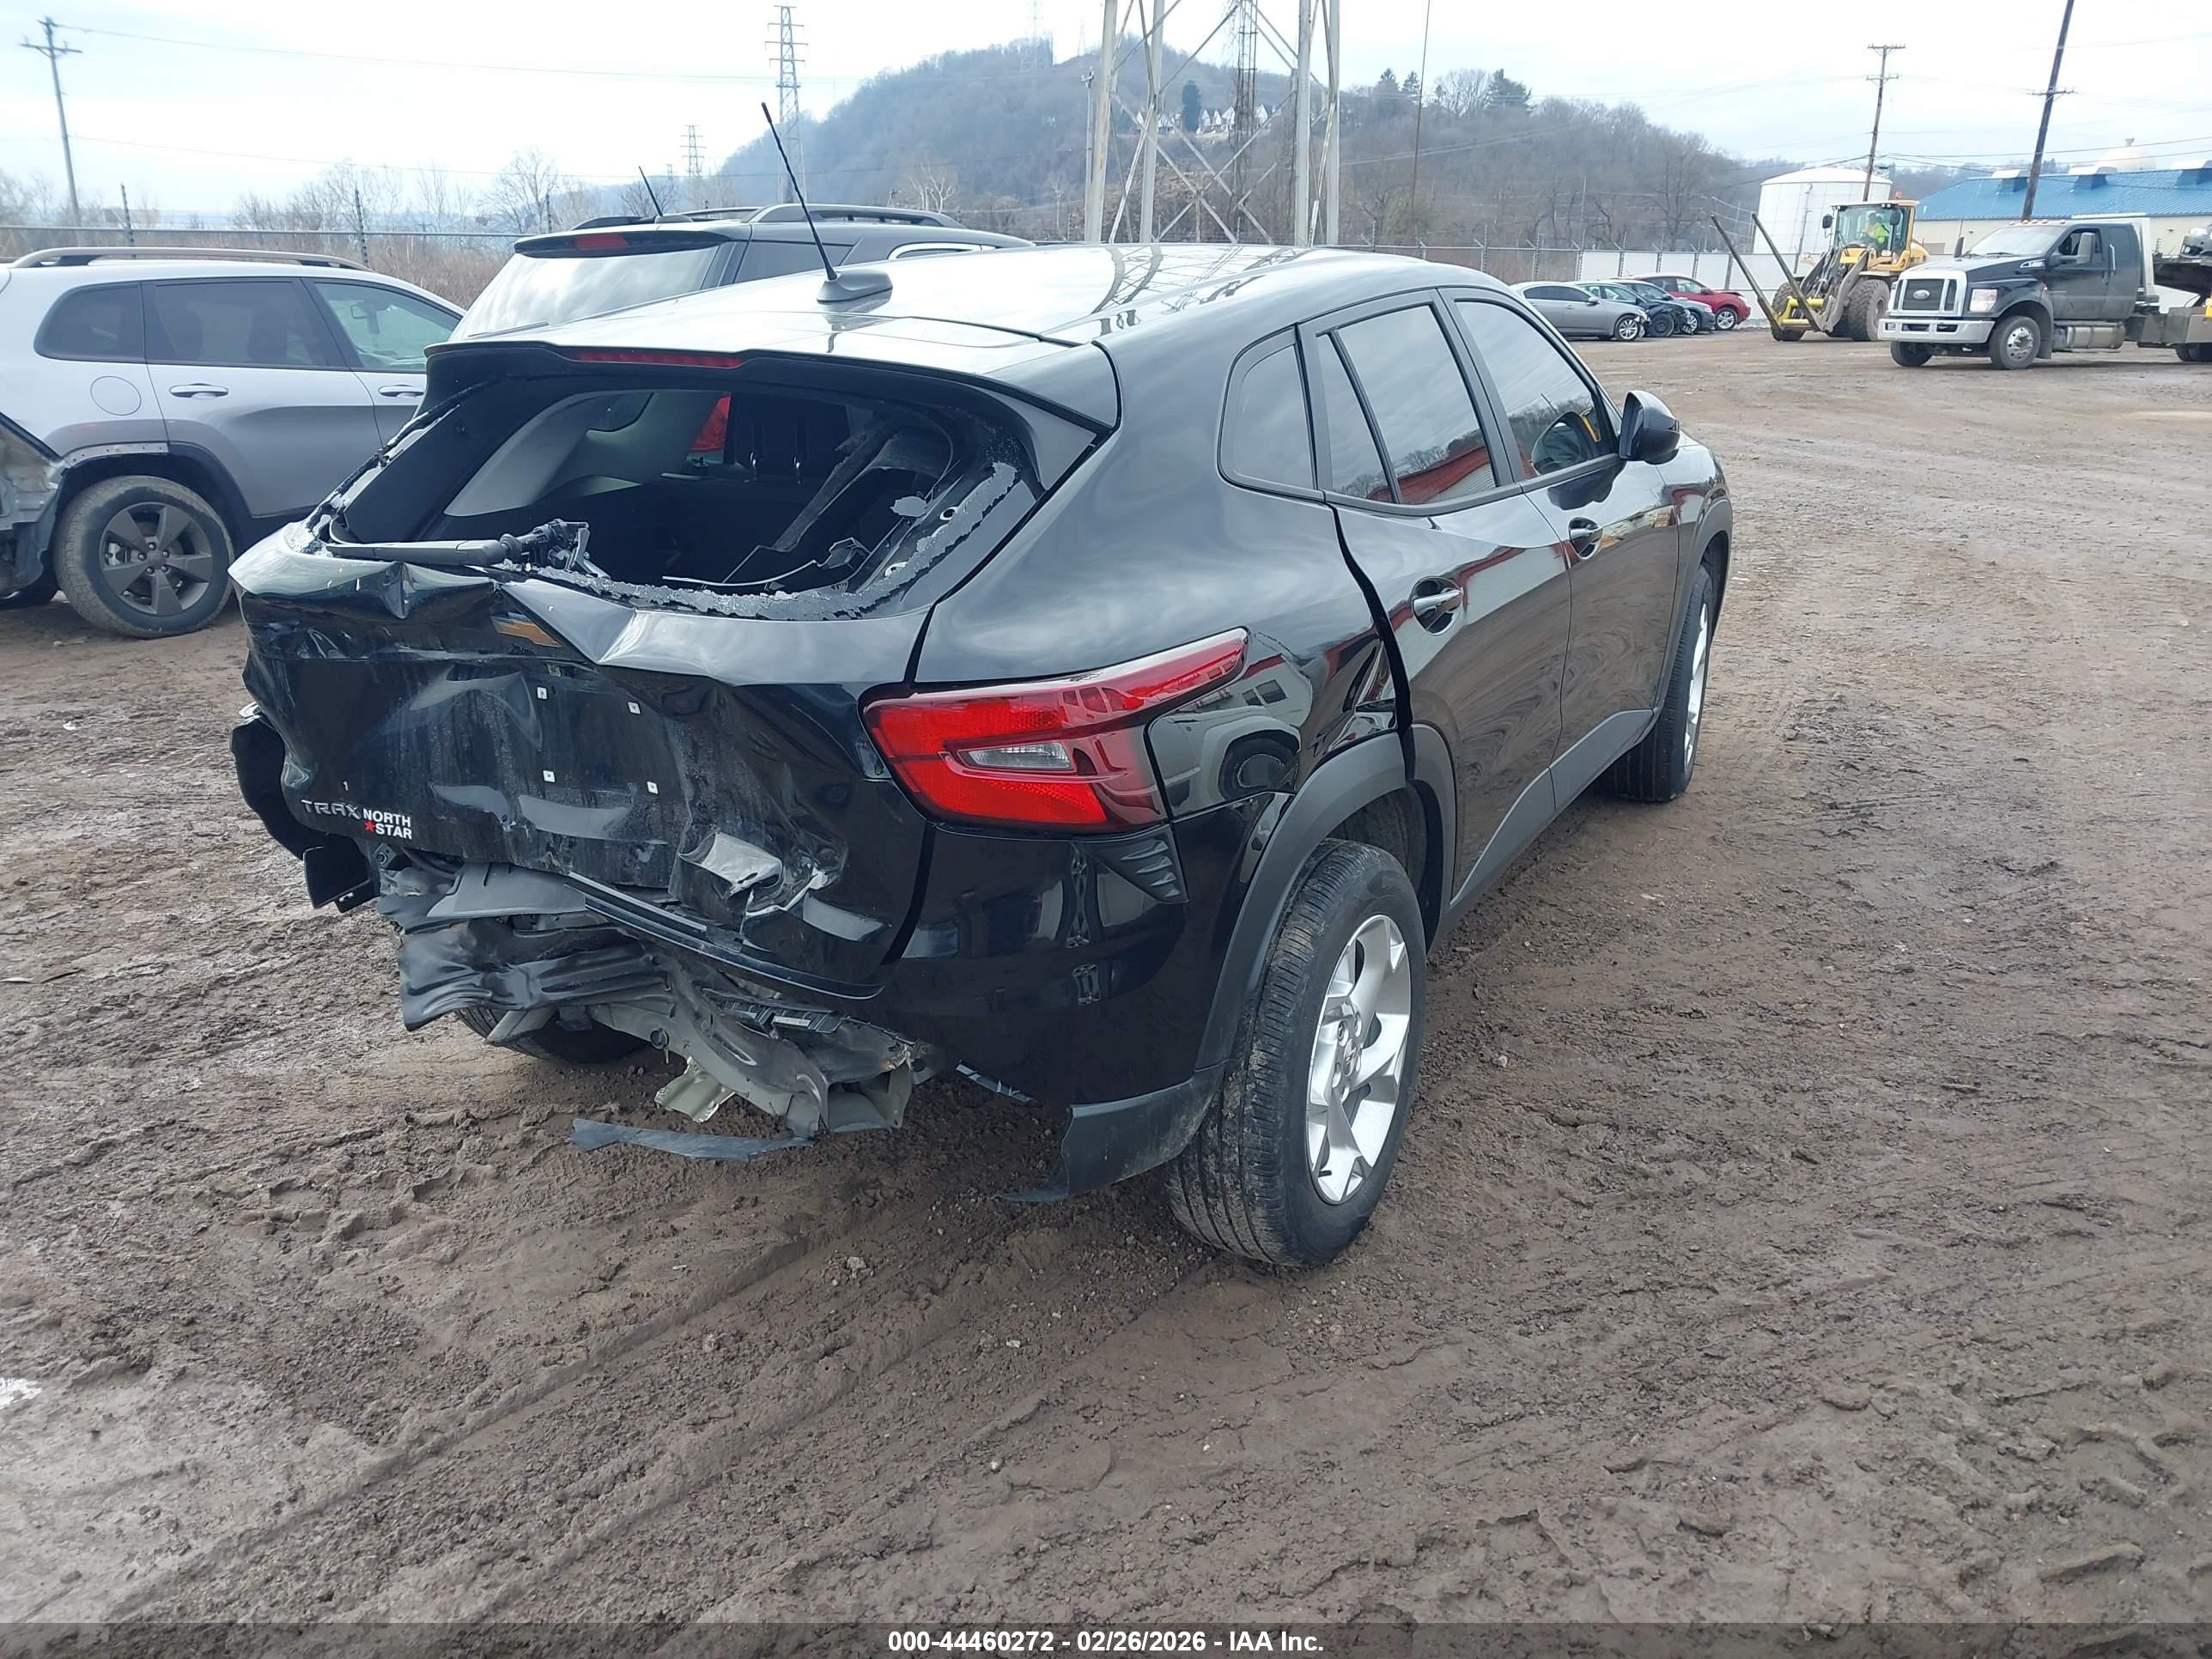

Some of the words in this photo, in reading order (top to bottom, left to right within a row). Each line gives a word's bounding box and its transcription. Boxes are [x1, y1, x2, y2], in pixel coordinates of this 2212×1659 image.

[301, 799, 361, 820] TRAX
[362, 808, 411, 828] NORTH
[375, 823, 413, 840] STAR
